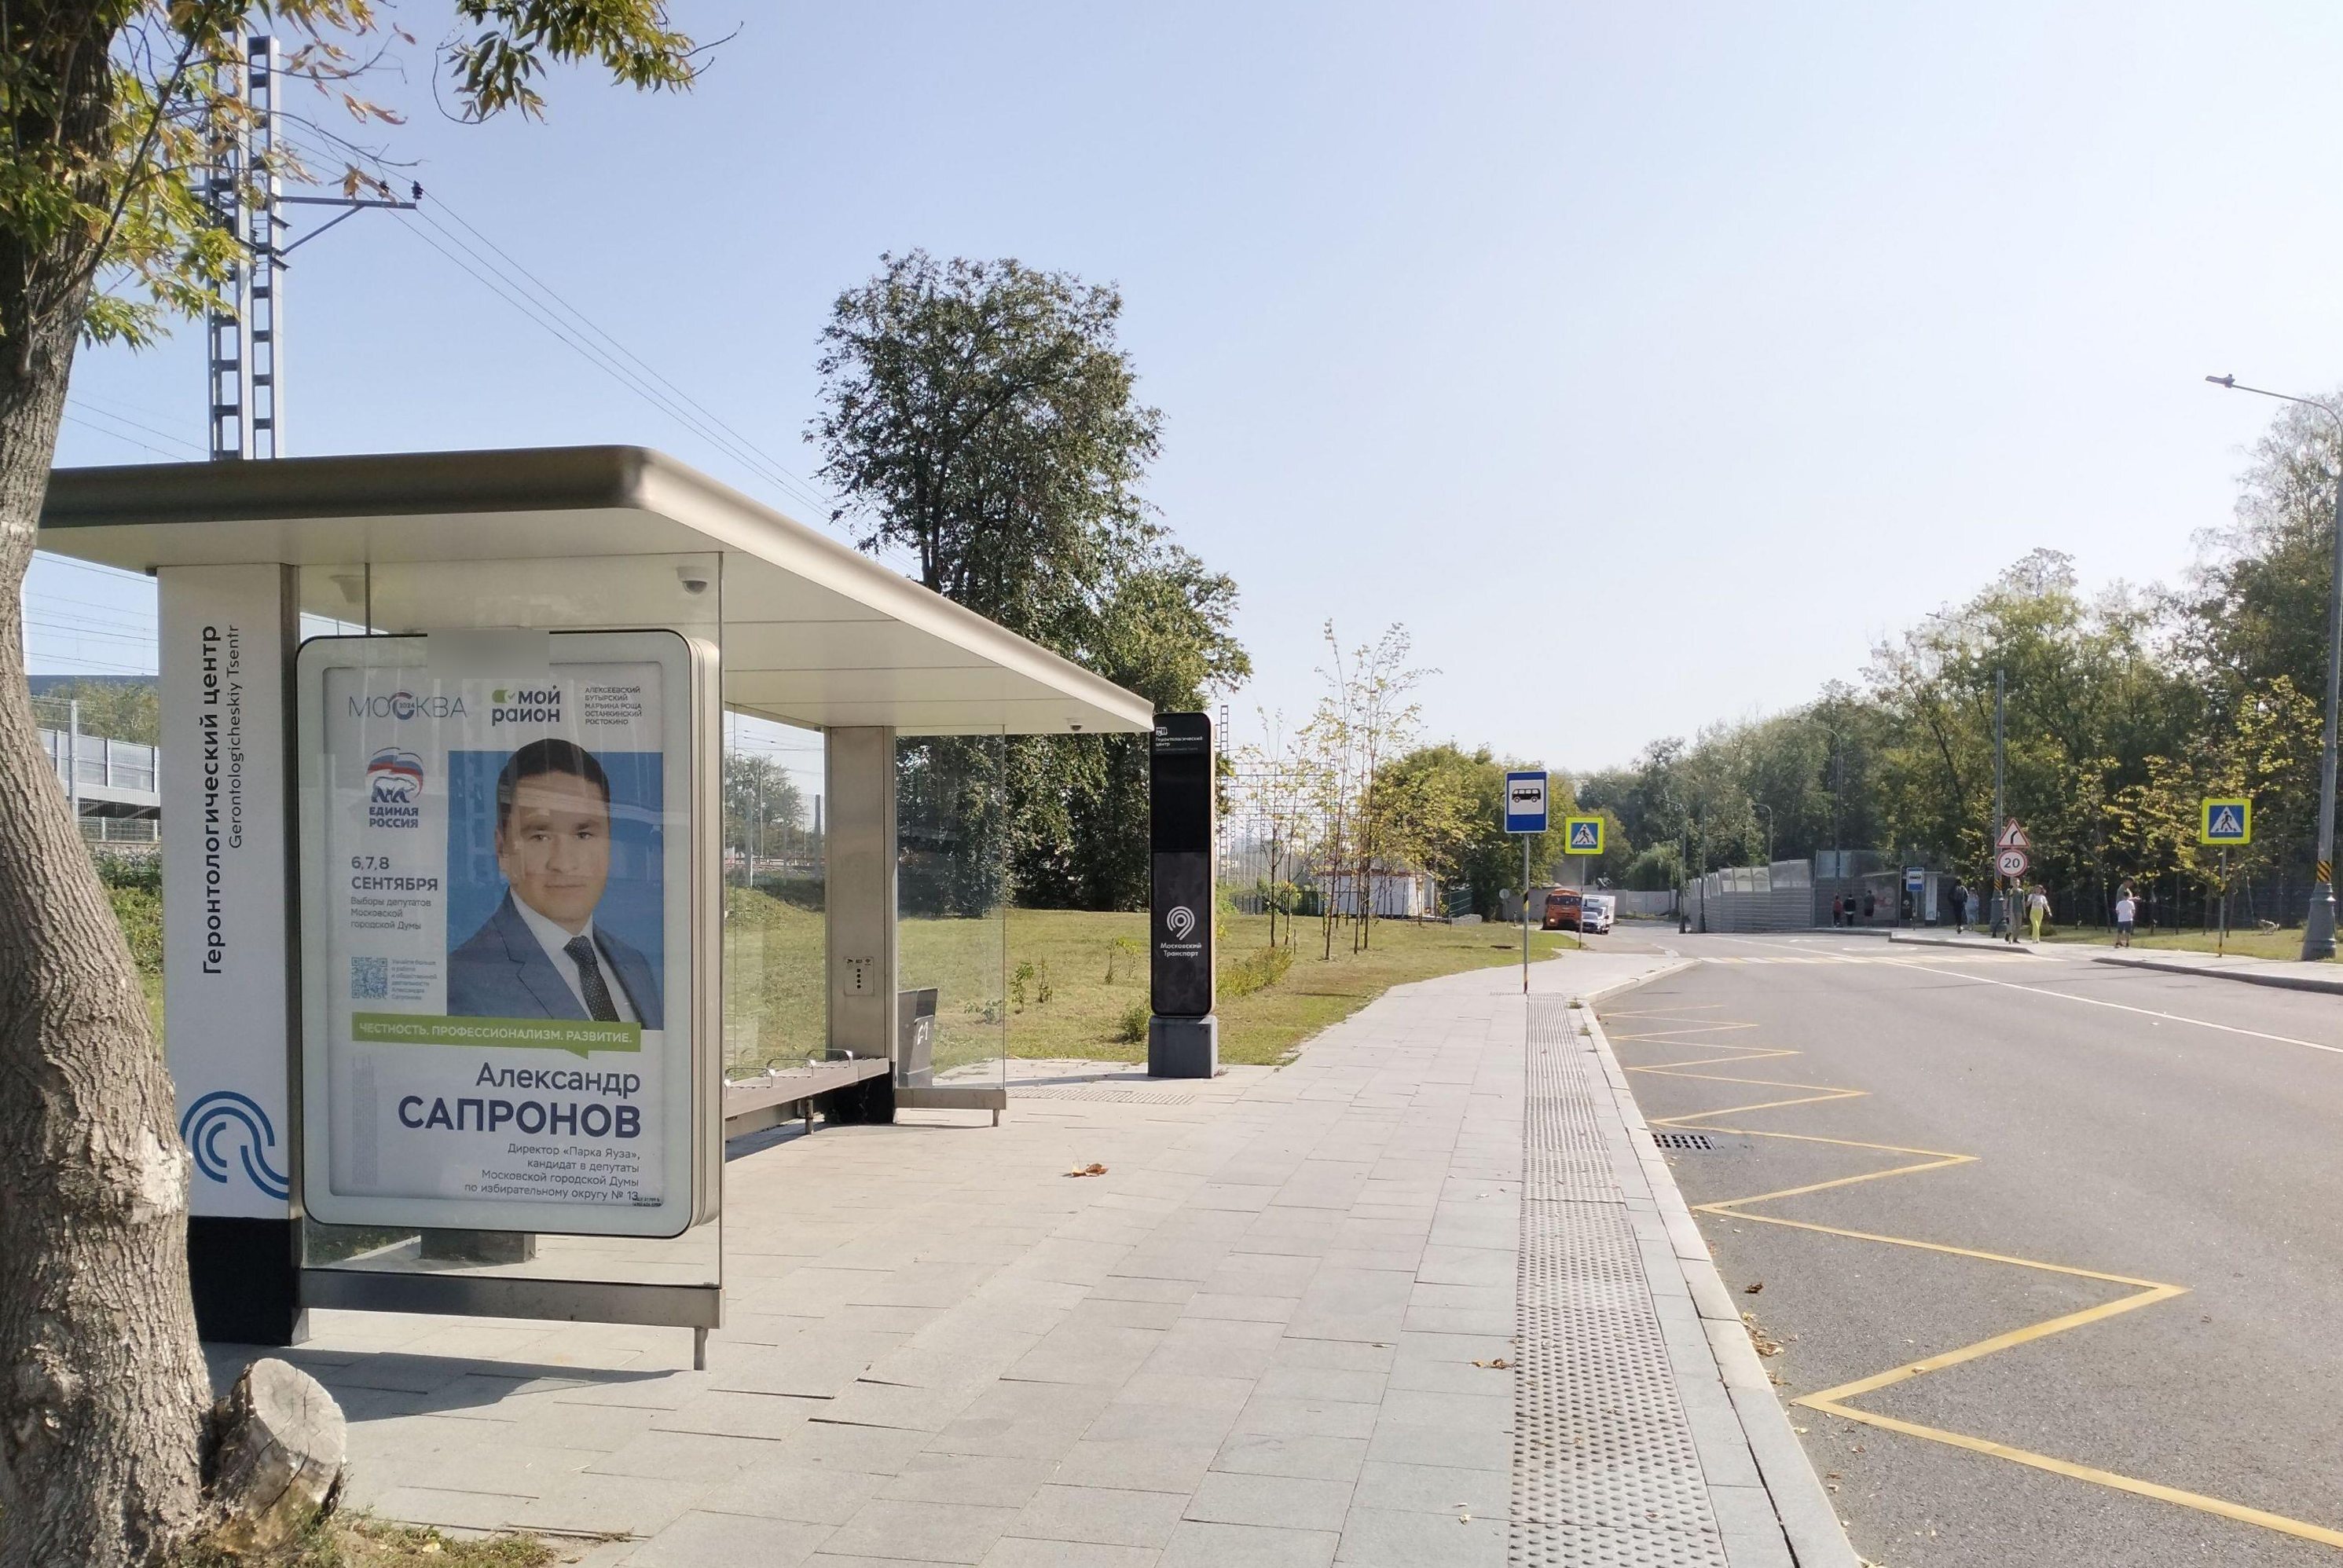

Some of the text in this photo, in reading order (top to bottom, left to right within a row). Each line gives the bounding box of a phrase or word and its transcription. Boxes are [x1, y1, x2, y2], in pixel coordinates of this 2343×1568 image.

[518, 684, 561, 705] мой
[348, 691, 468, 720] МОСКВА
[226, 625, 244, 849] Gerontologicheskiy Tsentr
[200, 625, 226, 975] Геронтологический центр
[368, 807, 419, 817] ЕДИНАЯ
[368, 818, 419, 829] РОССИЯ
[2004, 858, 2020, 868] 20
[351, 876, 438, 892] СЕНТЯБРЯ
[350, 896, 431, 908] Выборы депутатов
[350, 908, 403, 918] Московской
[350, 920, 422, 931] городской Думы
[359, 1023, 632, 1043] ЧЕСТНОСТЬ. ПРОФЕССИОНАЛИЗМ. РАЗВИТИЕ.
[475, 1061, 640, 1099] Александр
[398, 1095, 641, 1138] САПРОНОВ
[508, 1143, 640, 1161] Директор «Парка Яуза»,
[527, 1159, 577, 1171] кандидат
[588, 1163, 640, 1174] депутаты
[482, 1170, 639, 1188] Московской городской Думы
[464, 1184, 478, 1192] по
[481, 1184, 569, 1198] избирательному
[571, 1189, 608, 1200] округу
[611, 1190, 623, 1200] №
[626, 1191, 638, 1201] 13
